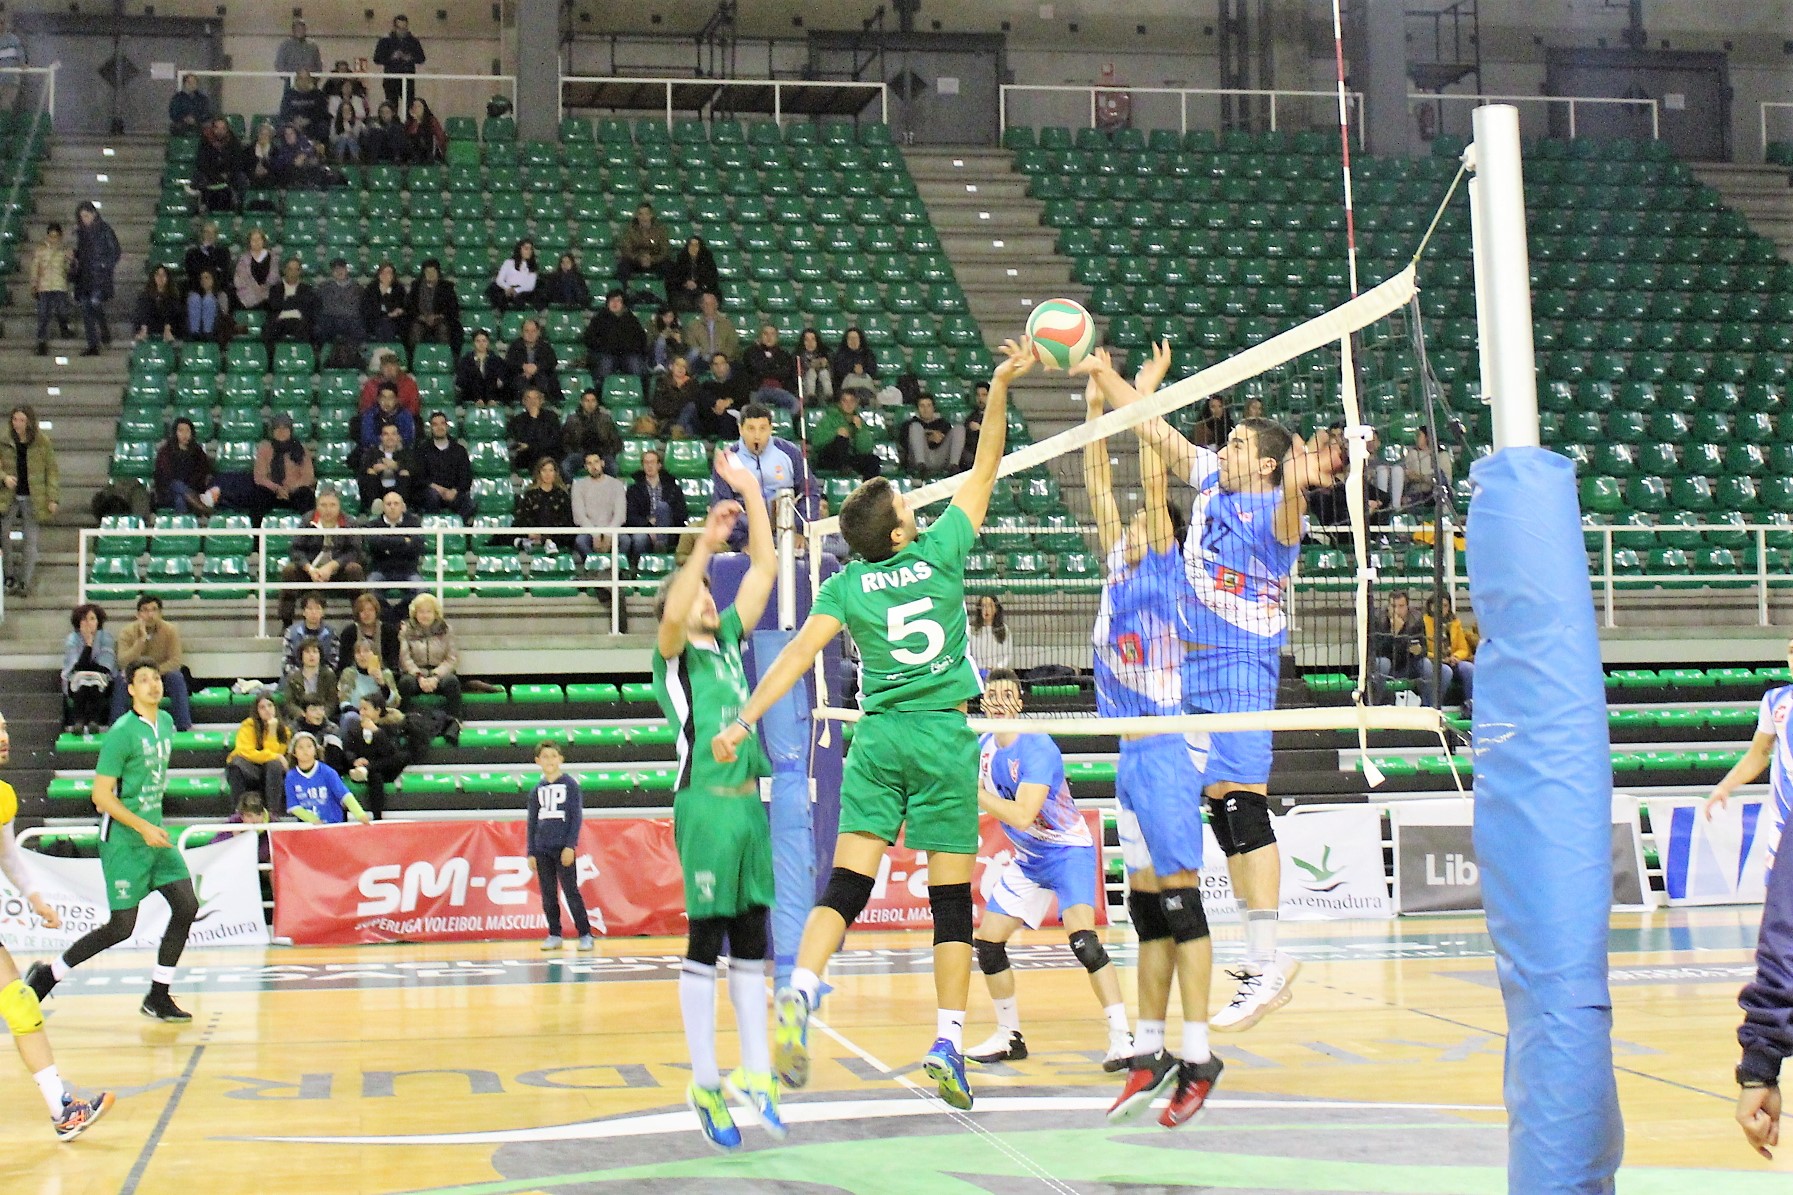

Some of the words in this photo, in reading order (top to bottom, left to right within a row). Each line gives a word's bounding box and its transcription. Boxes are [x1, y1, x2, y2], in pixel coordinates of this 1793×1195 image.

[861, 561, 932, 593] RIVAS
[887, 597, 945, 665] 5
[1425, 853, 1479, 886] Lib
[357, 856, 534, 916] SM-2
[424, 916, 484, 932] VOLEIBOL
[485, 913, 550, 931] MASCULIN
[855, 908, 906, 924] OLEIBOL
